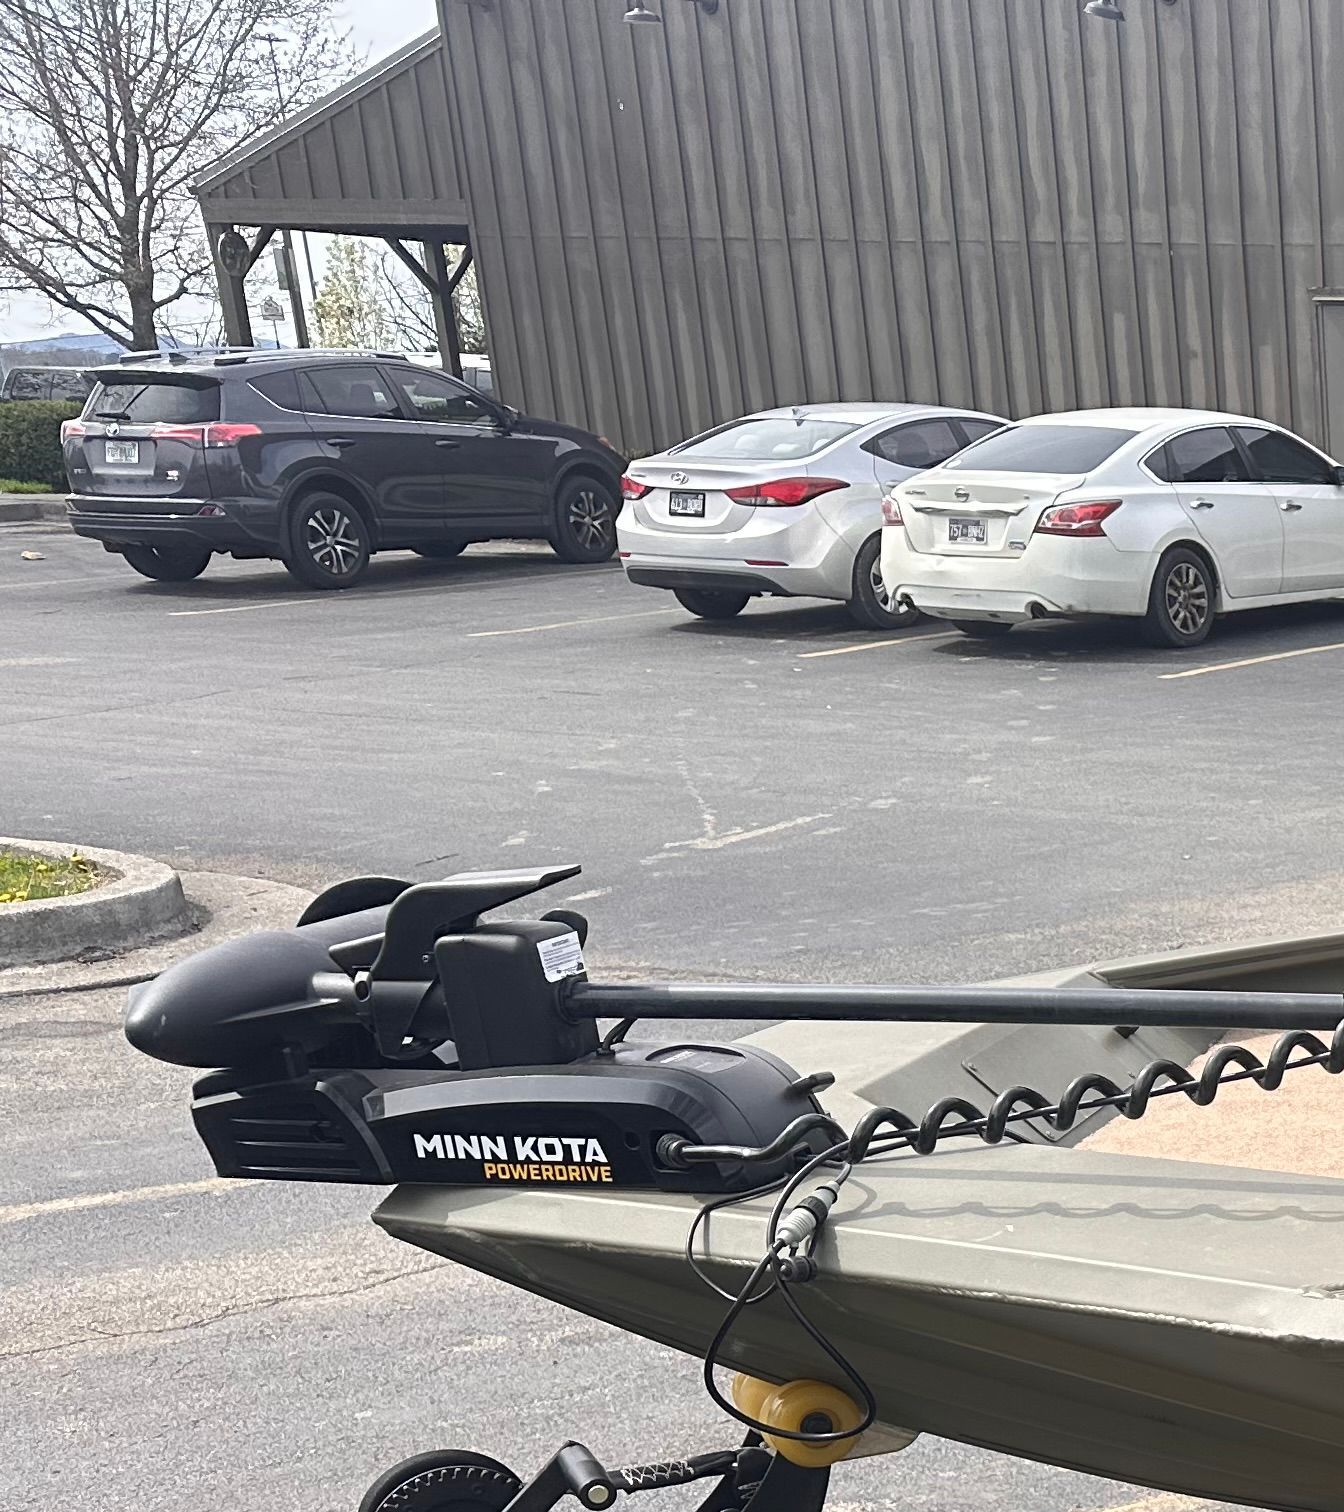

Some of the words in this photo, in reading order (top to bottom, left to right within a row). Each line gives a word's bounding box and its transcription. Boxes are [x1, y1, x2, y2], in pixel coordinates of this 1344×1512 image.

[949, 524, 962, 537] 757
[412, 1133, 508, 1161] MINN
[513, 1136, 609, 1163] KOTA
[483, 1162, 614, 1182] POWERDRIVE
